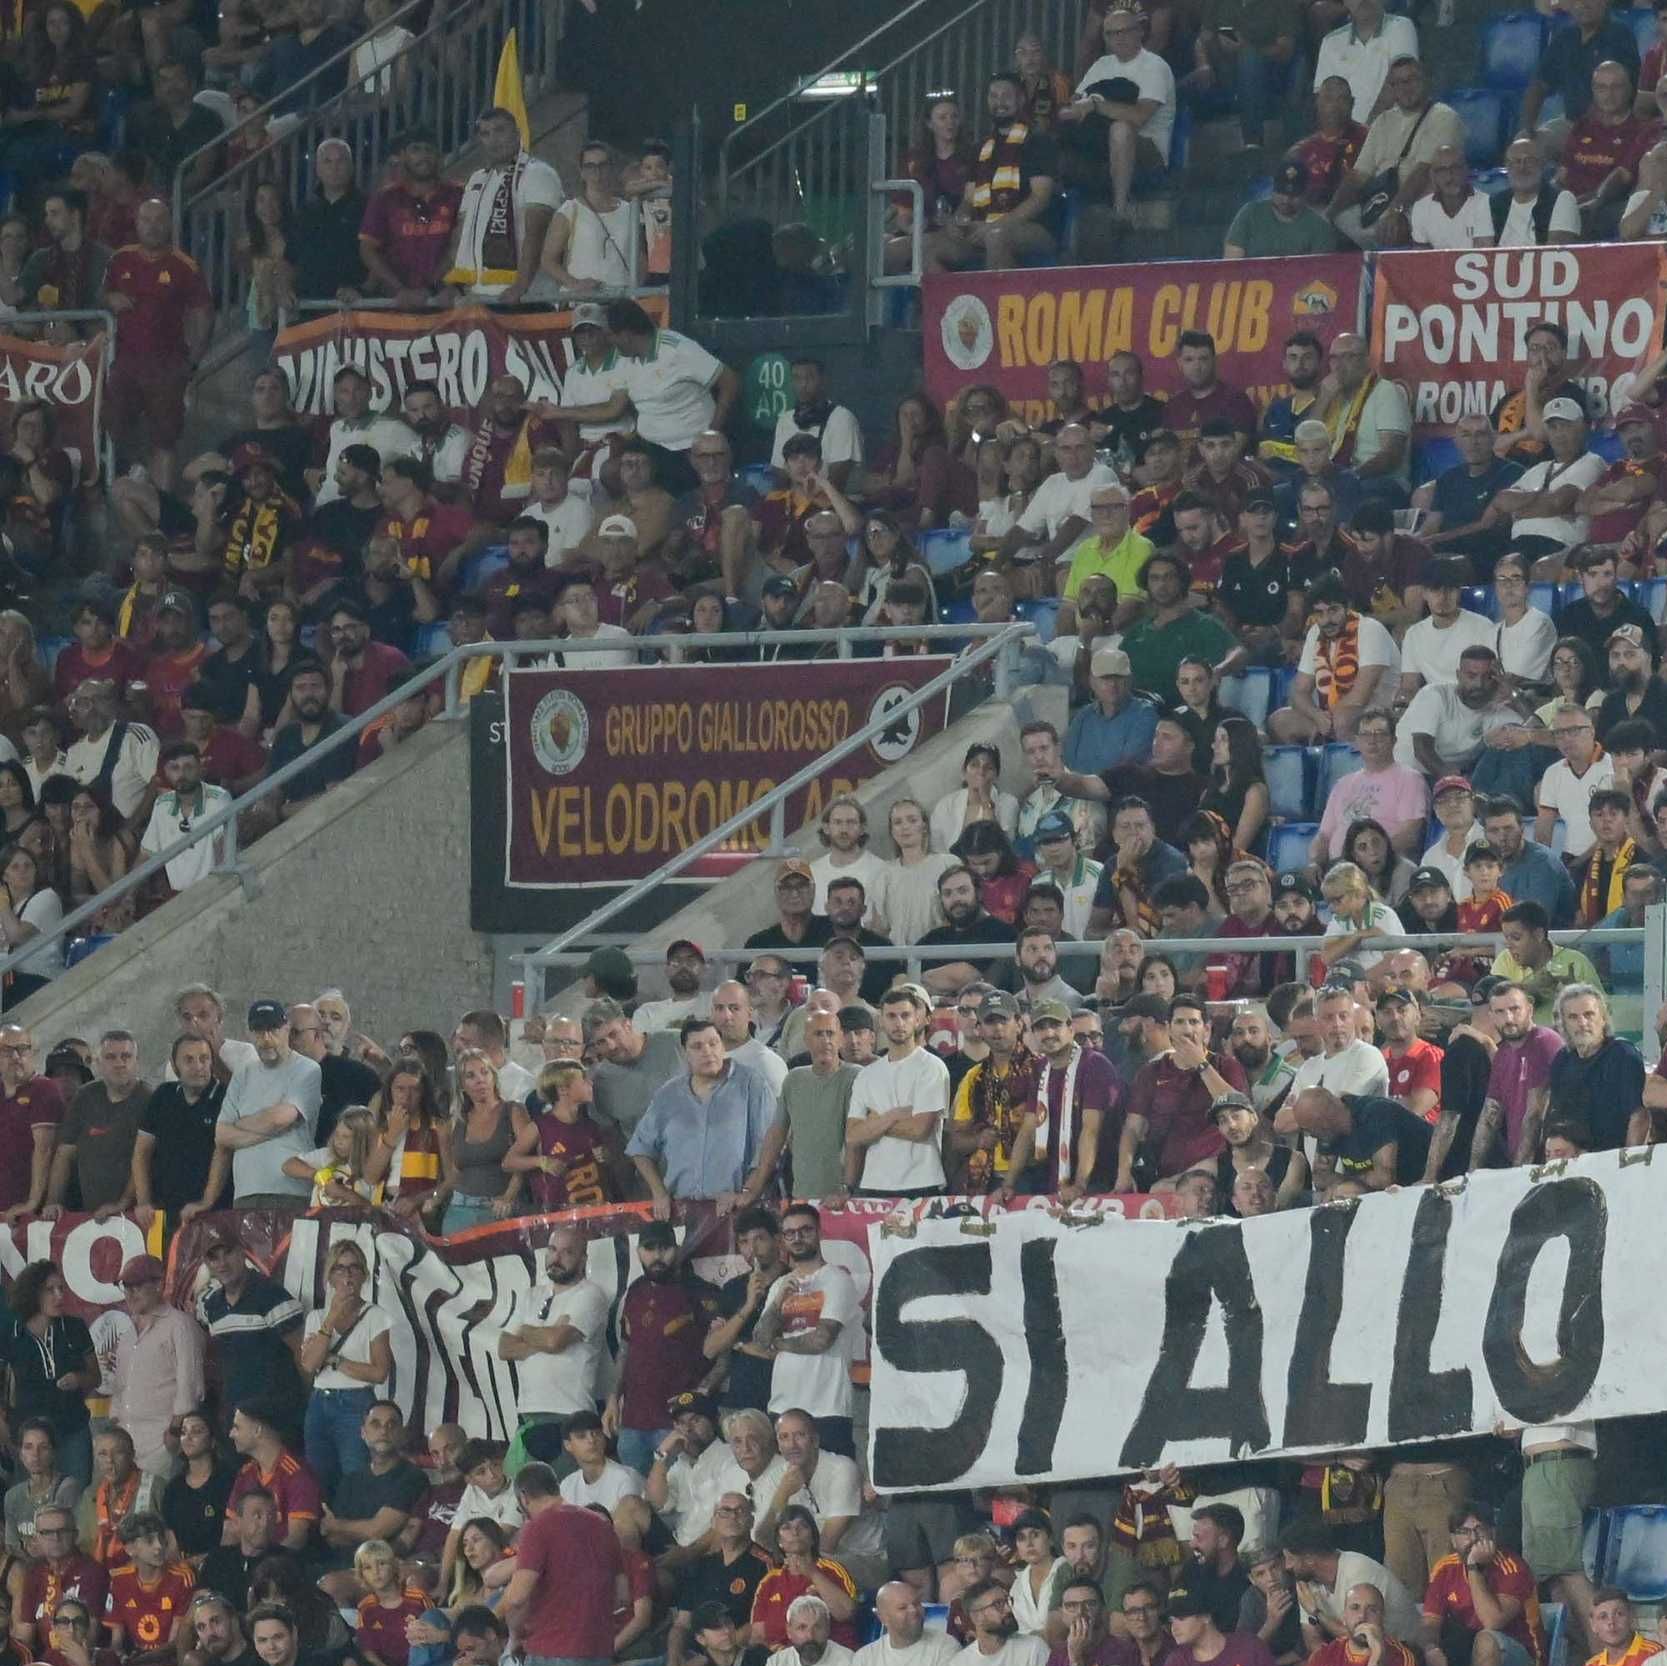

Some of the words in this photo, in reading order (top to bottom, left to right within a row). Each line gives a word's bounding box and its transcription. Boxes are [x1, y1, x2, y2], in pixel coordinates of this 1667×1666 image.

[1453, 252, 1581, 300] SUD
[998, 290, 1137, 367] ROMA
[1149, 281, 1273, 360] CLUB
[1385, 298, 1654, 366] PONTINO
[760, 362, 784, 386] 40
[1416, 380, 1510, 424] ROMA
[605, 703, 696, 750] GRUPPO
[700, 697, 850, 751] GIALLOROSSO
[873, 1236, 1069, 1487] SI
[1118, 1174, 1608, 1470] ALLO
